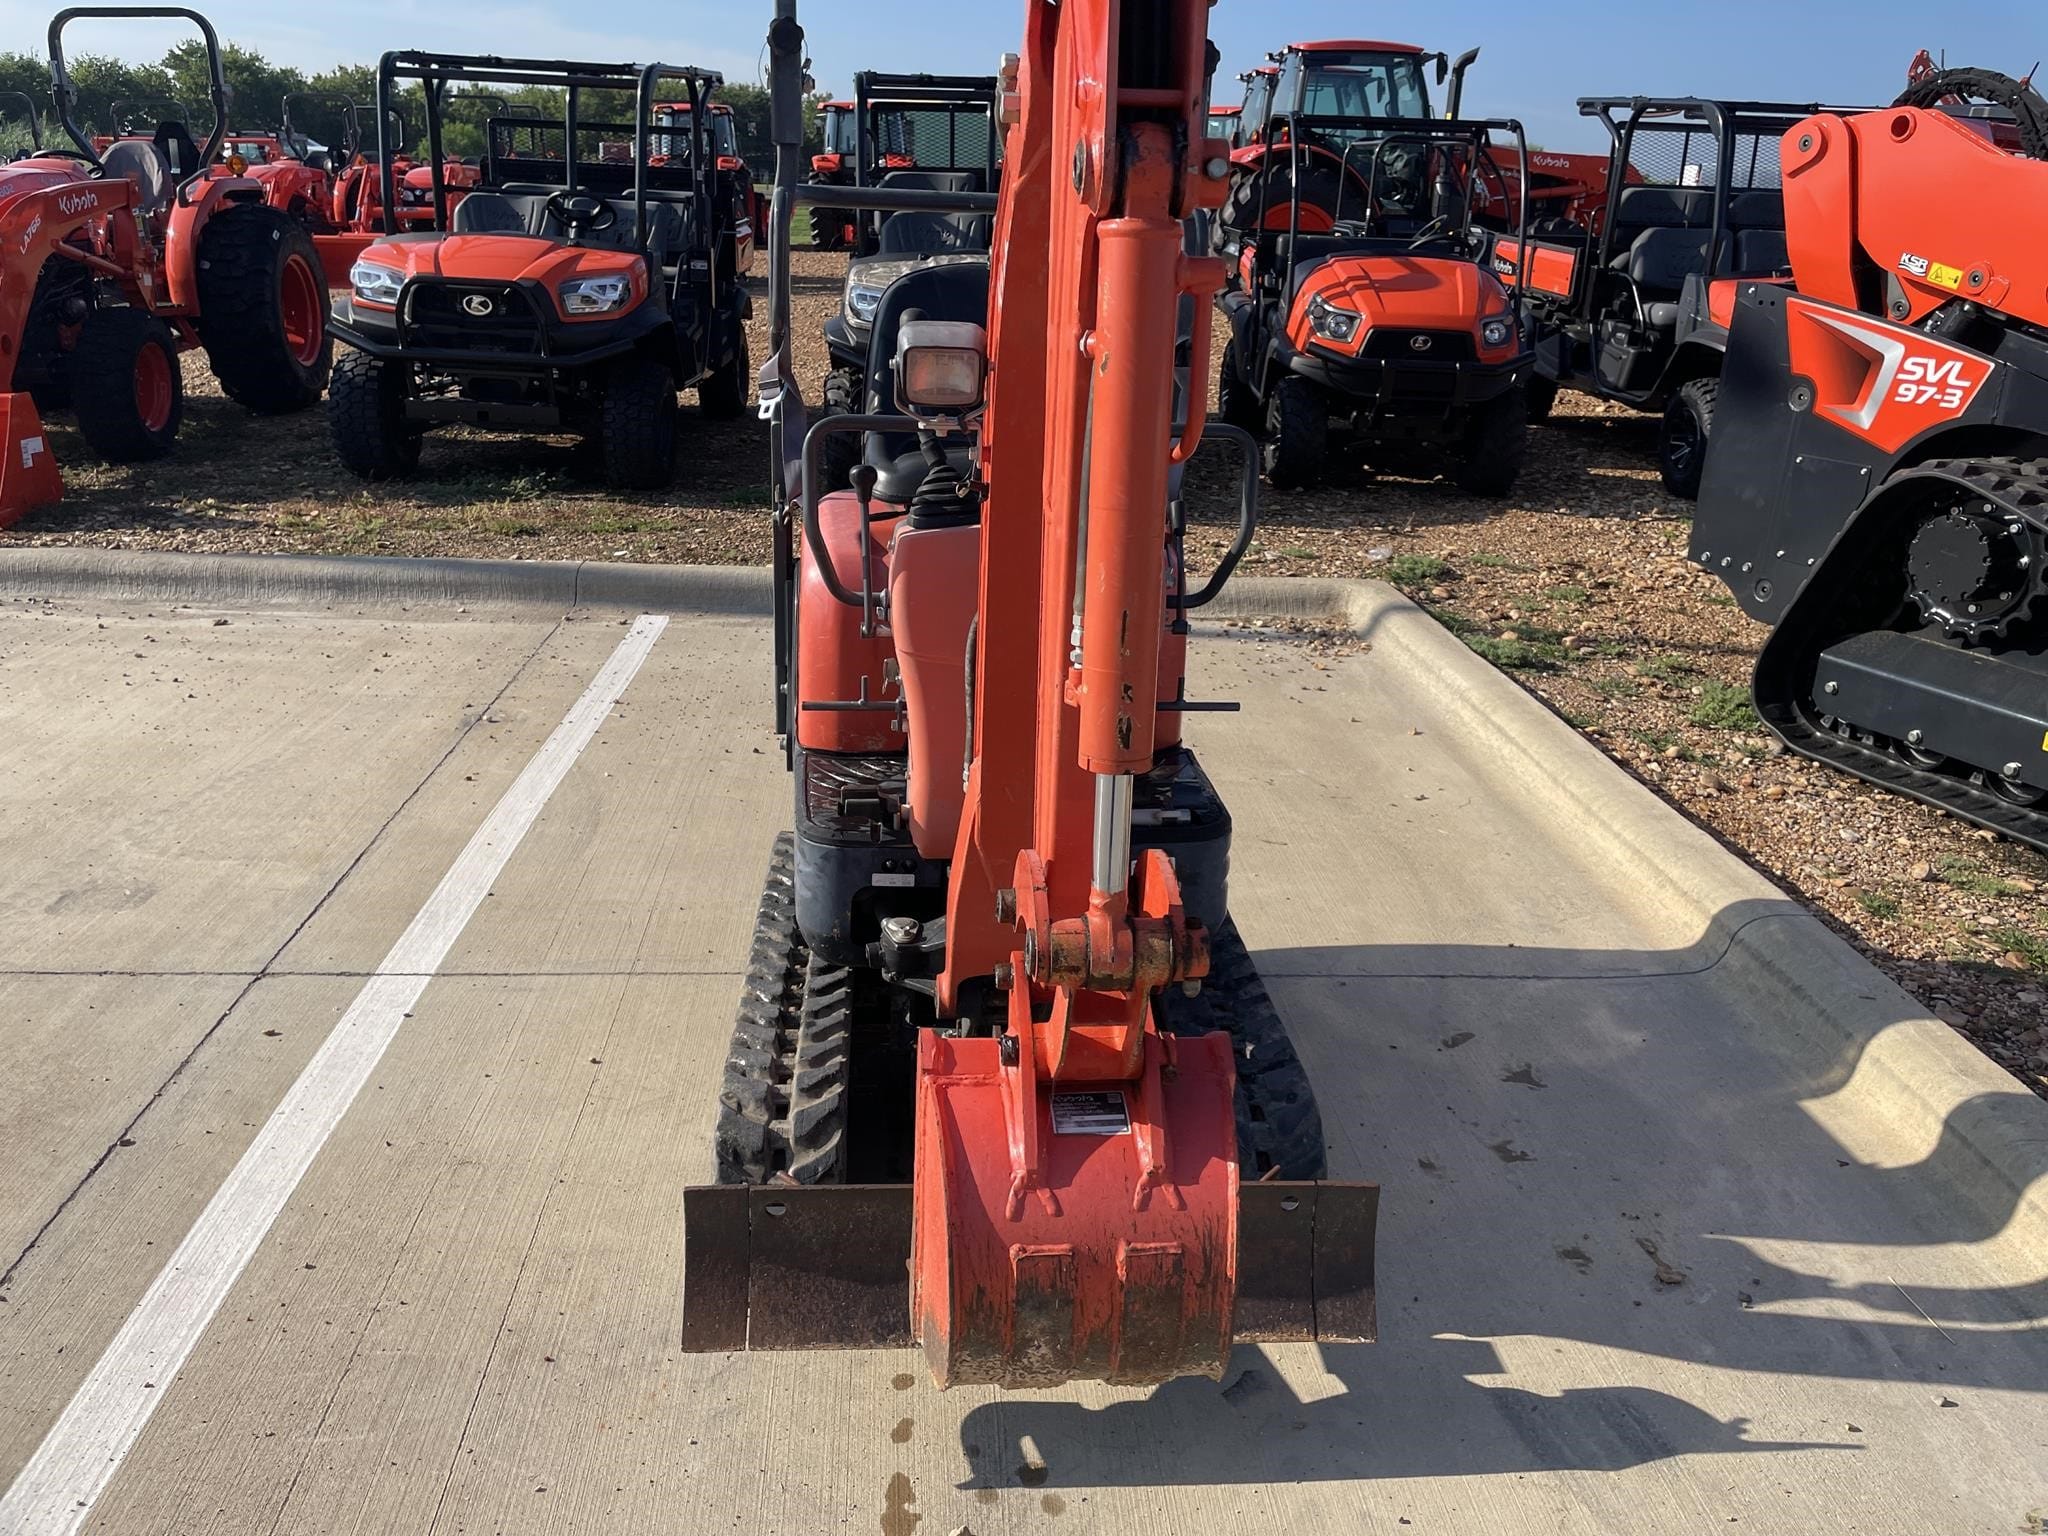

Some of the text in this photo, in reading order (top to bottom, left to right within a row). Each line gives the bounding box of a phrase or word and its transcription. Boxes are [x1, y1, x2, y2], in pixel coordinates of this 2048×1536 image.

[1533, 155, 1569, 168] Kubota
[58, 190, 98, 215] Kubota
[1900, 252, 1929, 270] KSR
[1896, 356, 1972, 387] SVL
[1894, 383, 1964, 408] 97-3
